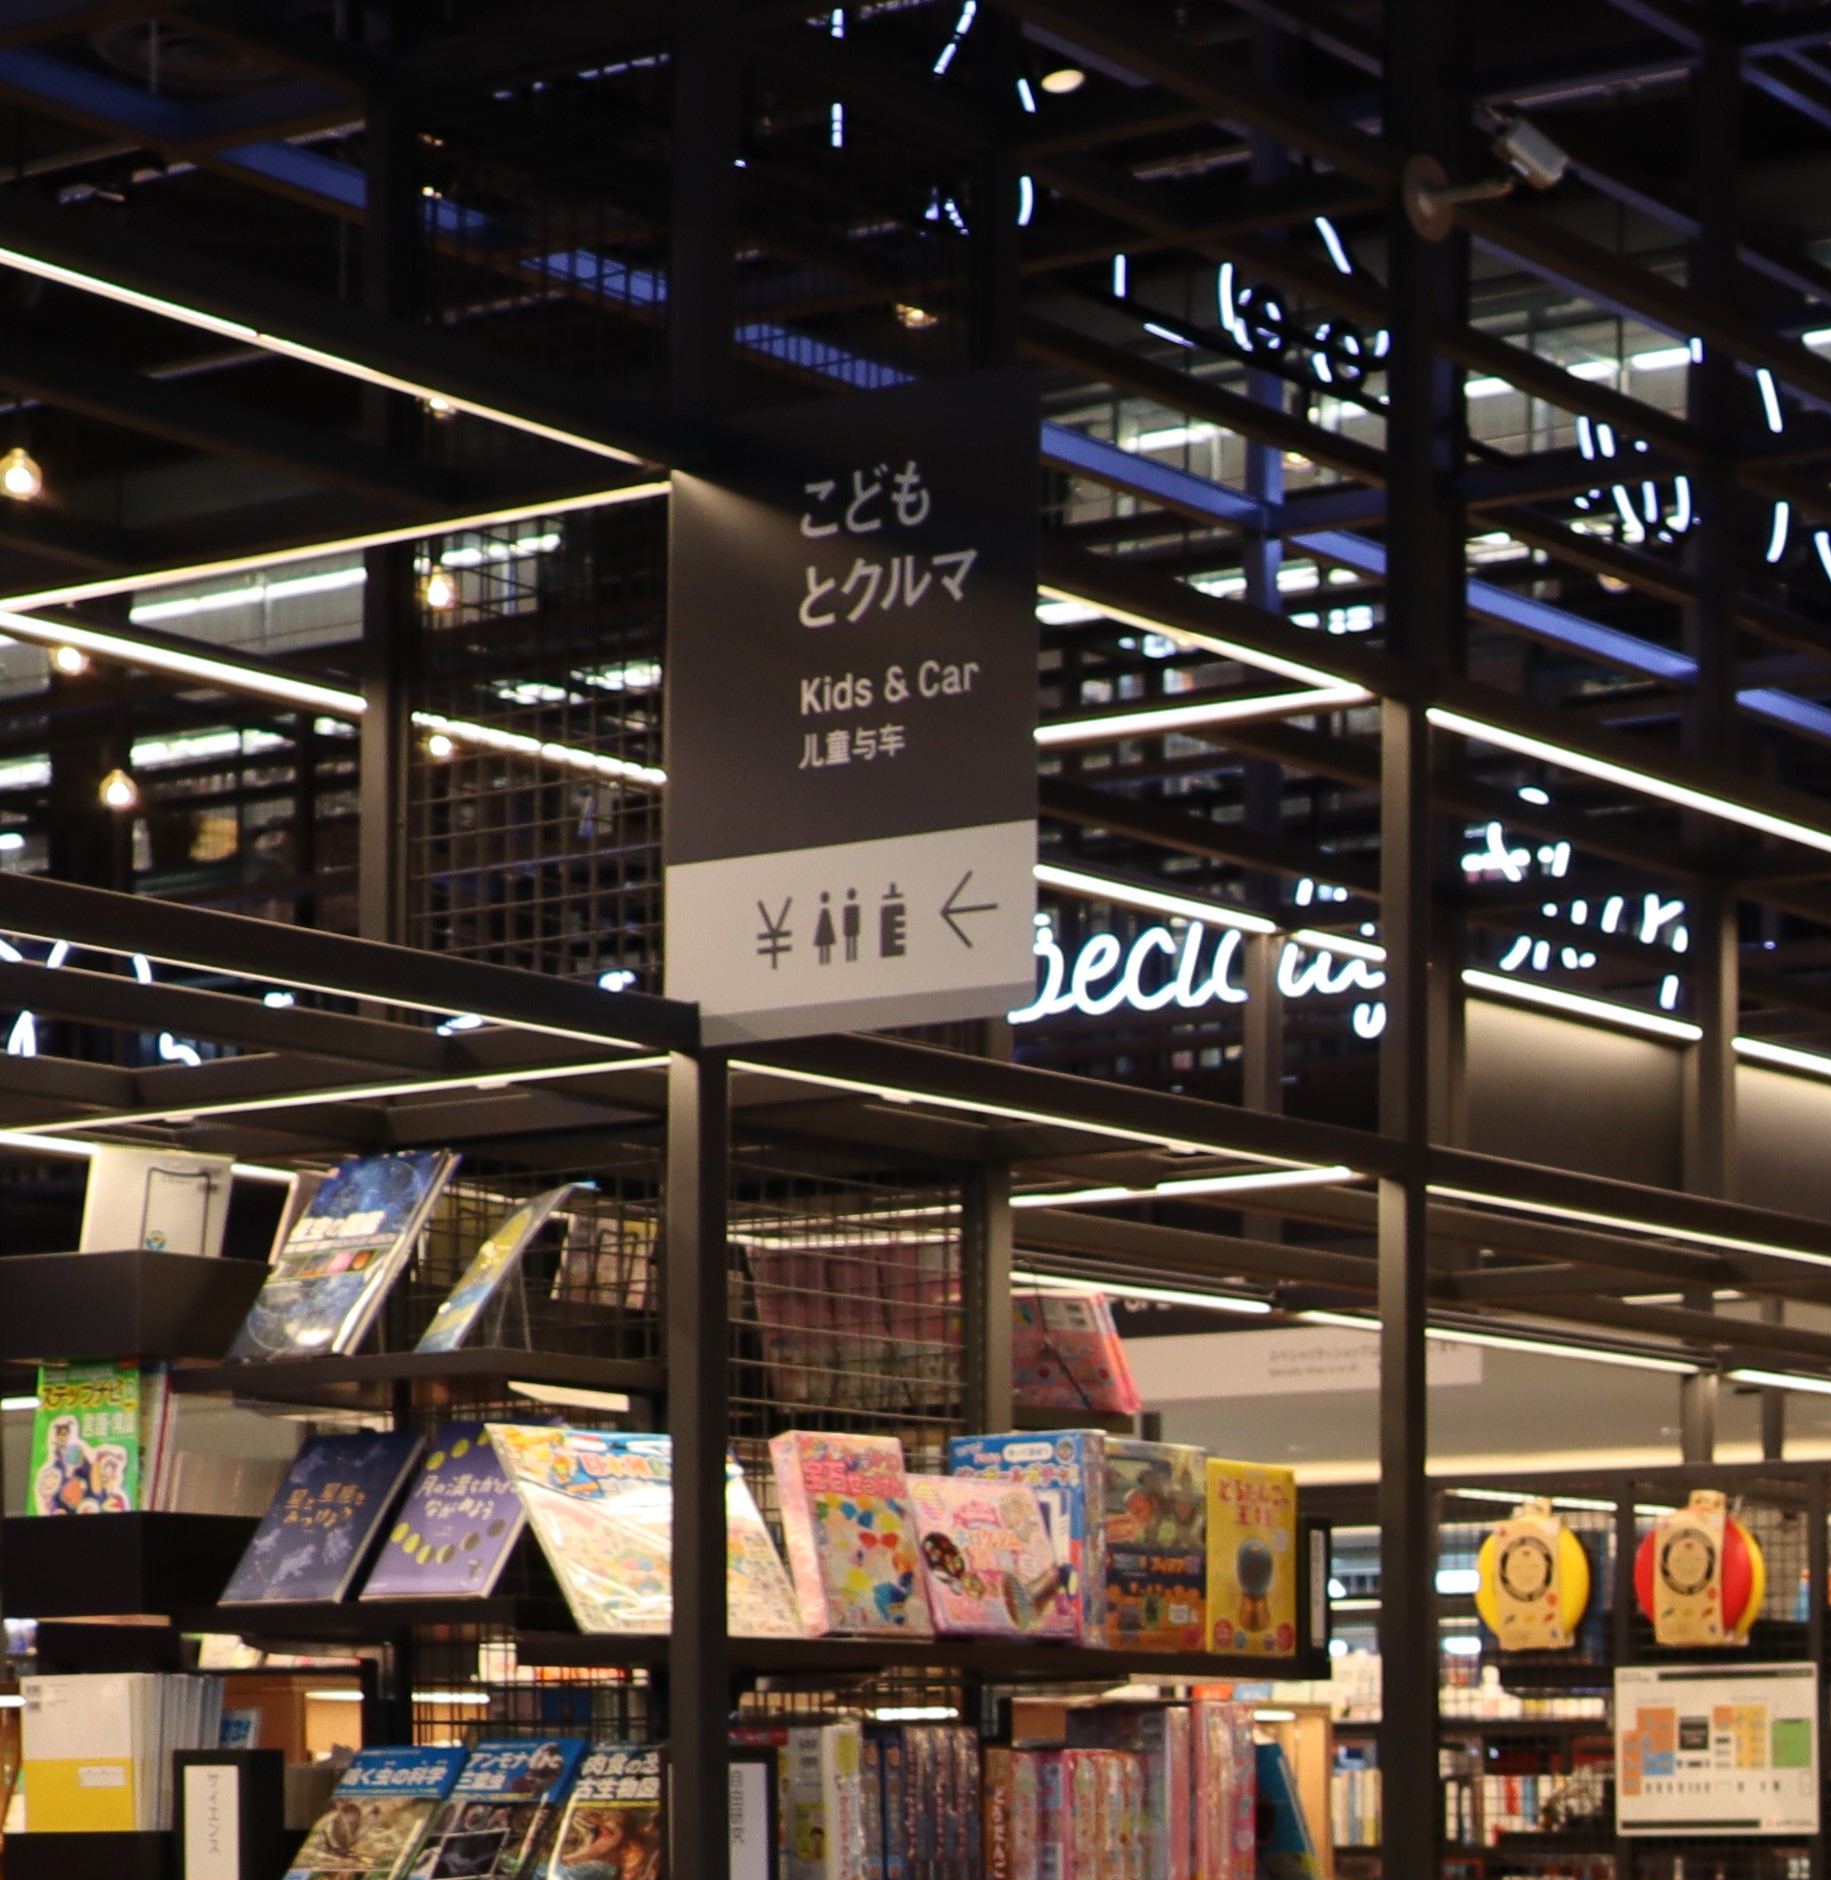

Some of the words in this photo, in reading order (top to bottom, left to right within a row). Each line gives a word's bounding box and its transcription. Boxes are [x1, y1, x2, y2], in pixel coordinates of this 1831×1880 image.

[801, 460, 930, 538] こども
[799, 549, 978, 628] とクルマ
[800, 672, 873, 715] Kids
[883, 665, 910, 702] &
[918, 659, 980, 698] Car
[799, 723, 905, 770] 儿童与车
